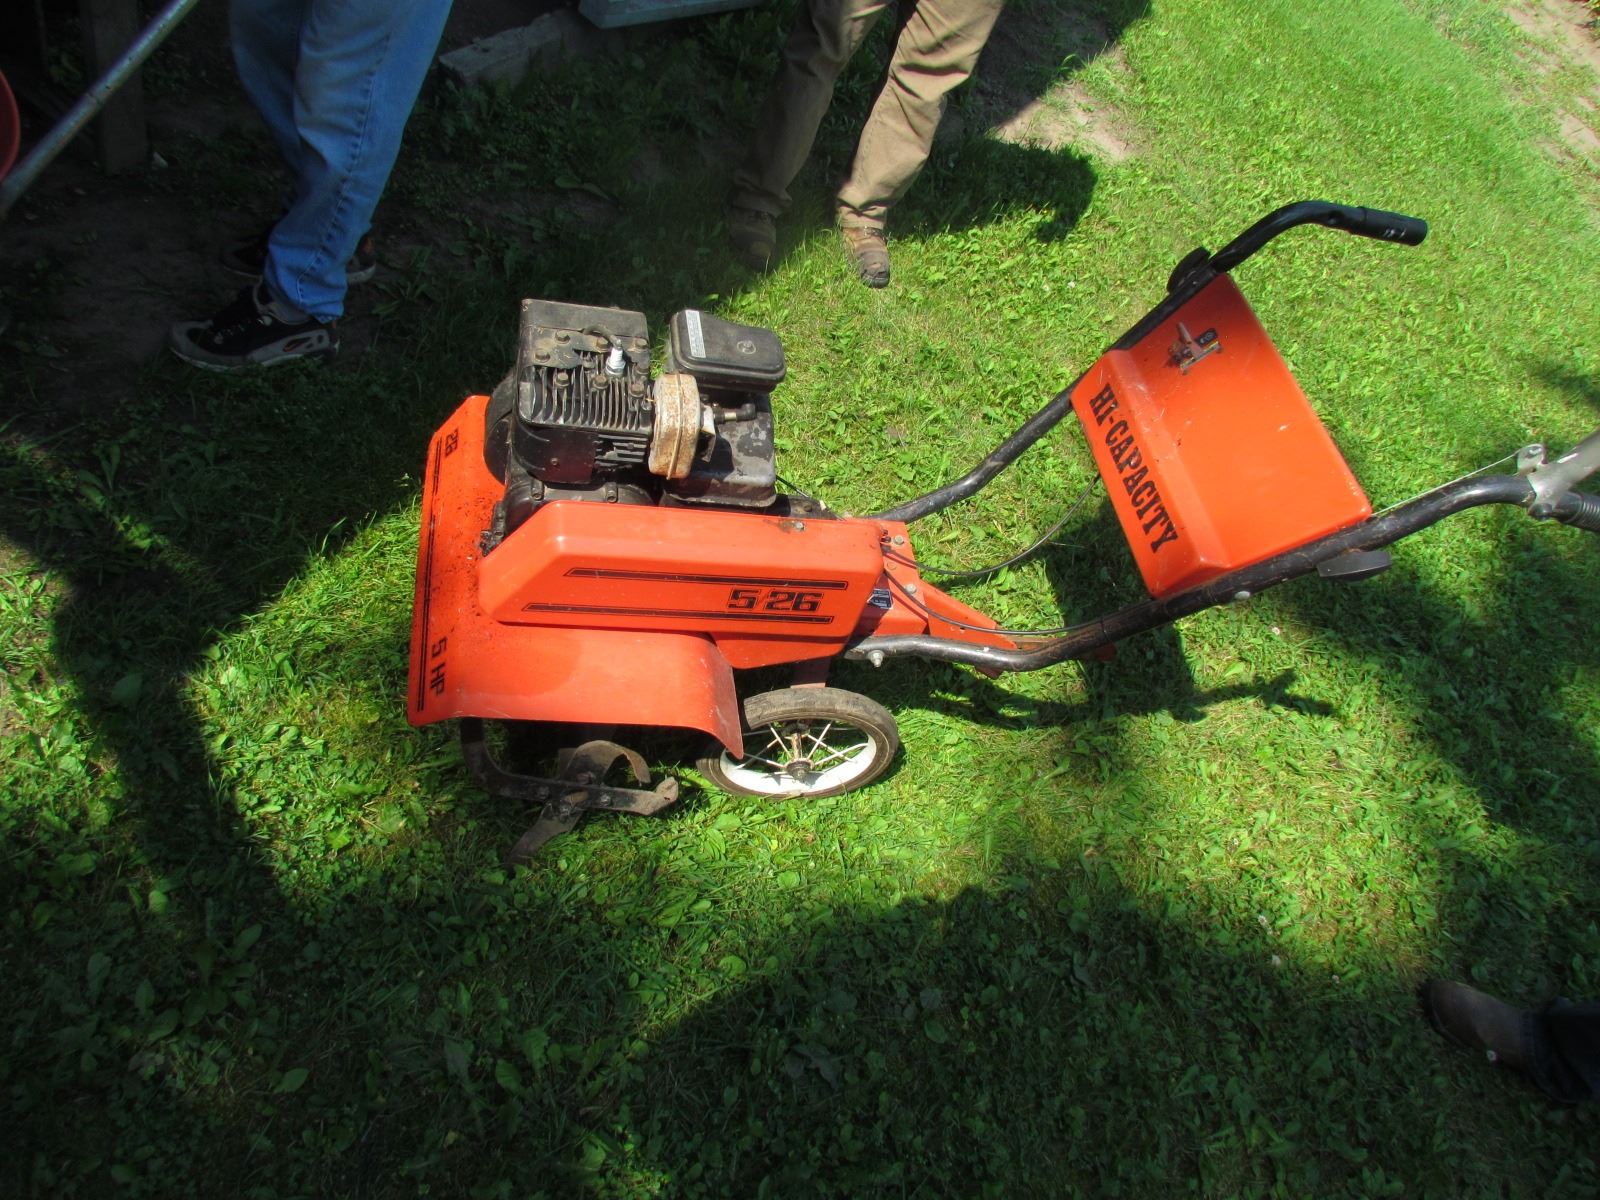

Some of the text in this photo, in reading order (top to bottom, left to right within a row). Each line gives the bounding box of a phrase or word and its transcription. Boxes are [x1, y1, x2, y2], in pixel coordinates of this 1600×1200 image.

[445, 428, 459, 457] 26
[1089, 383, 1178, 553] HI-CAPACITY
[430, 636, 447, 696] 5 HP
